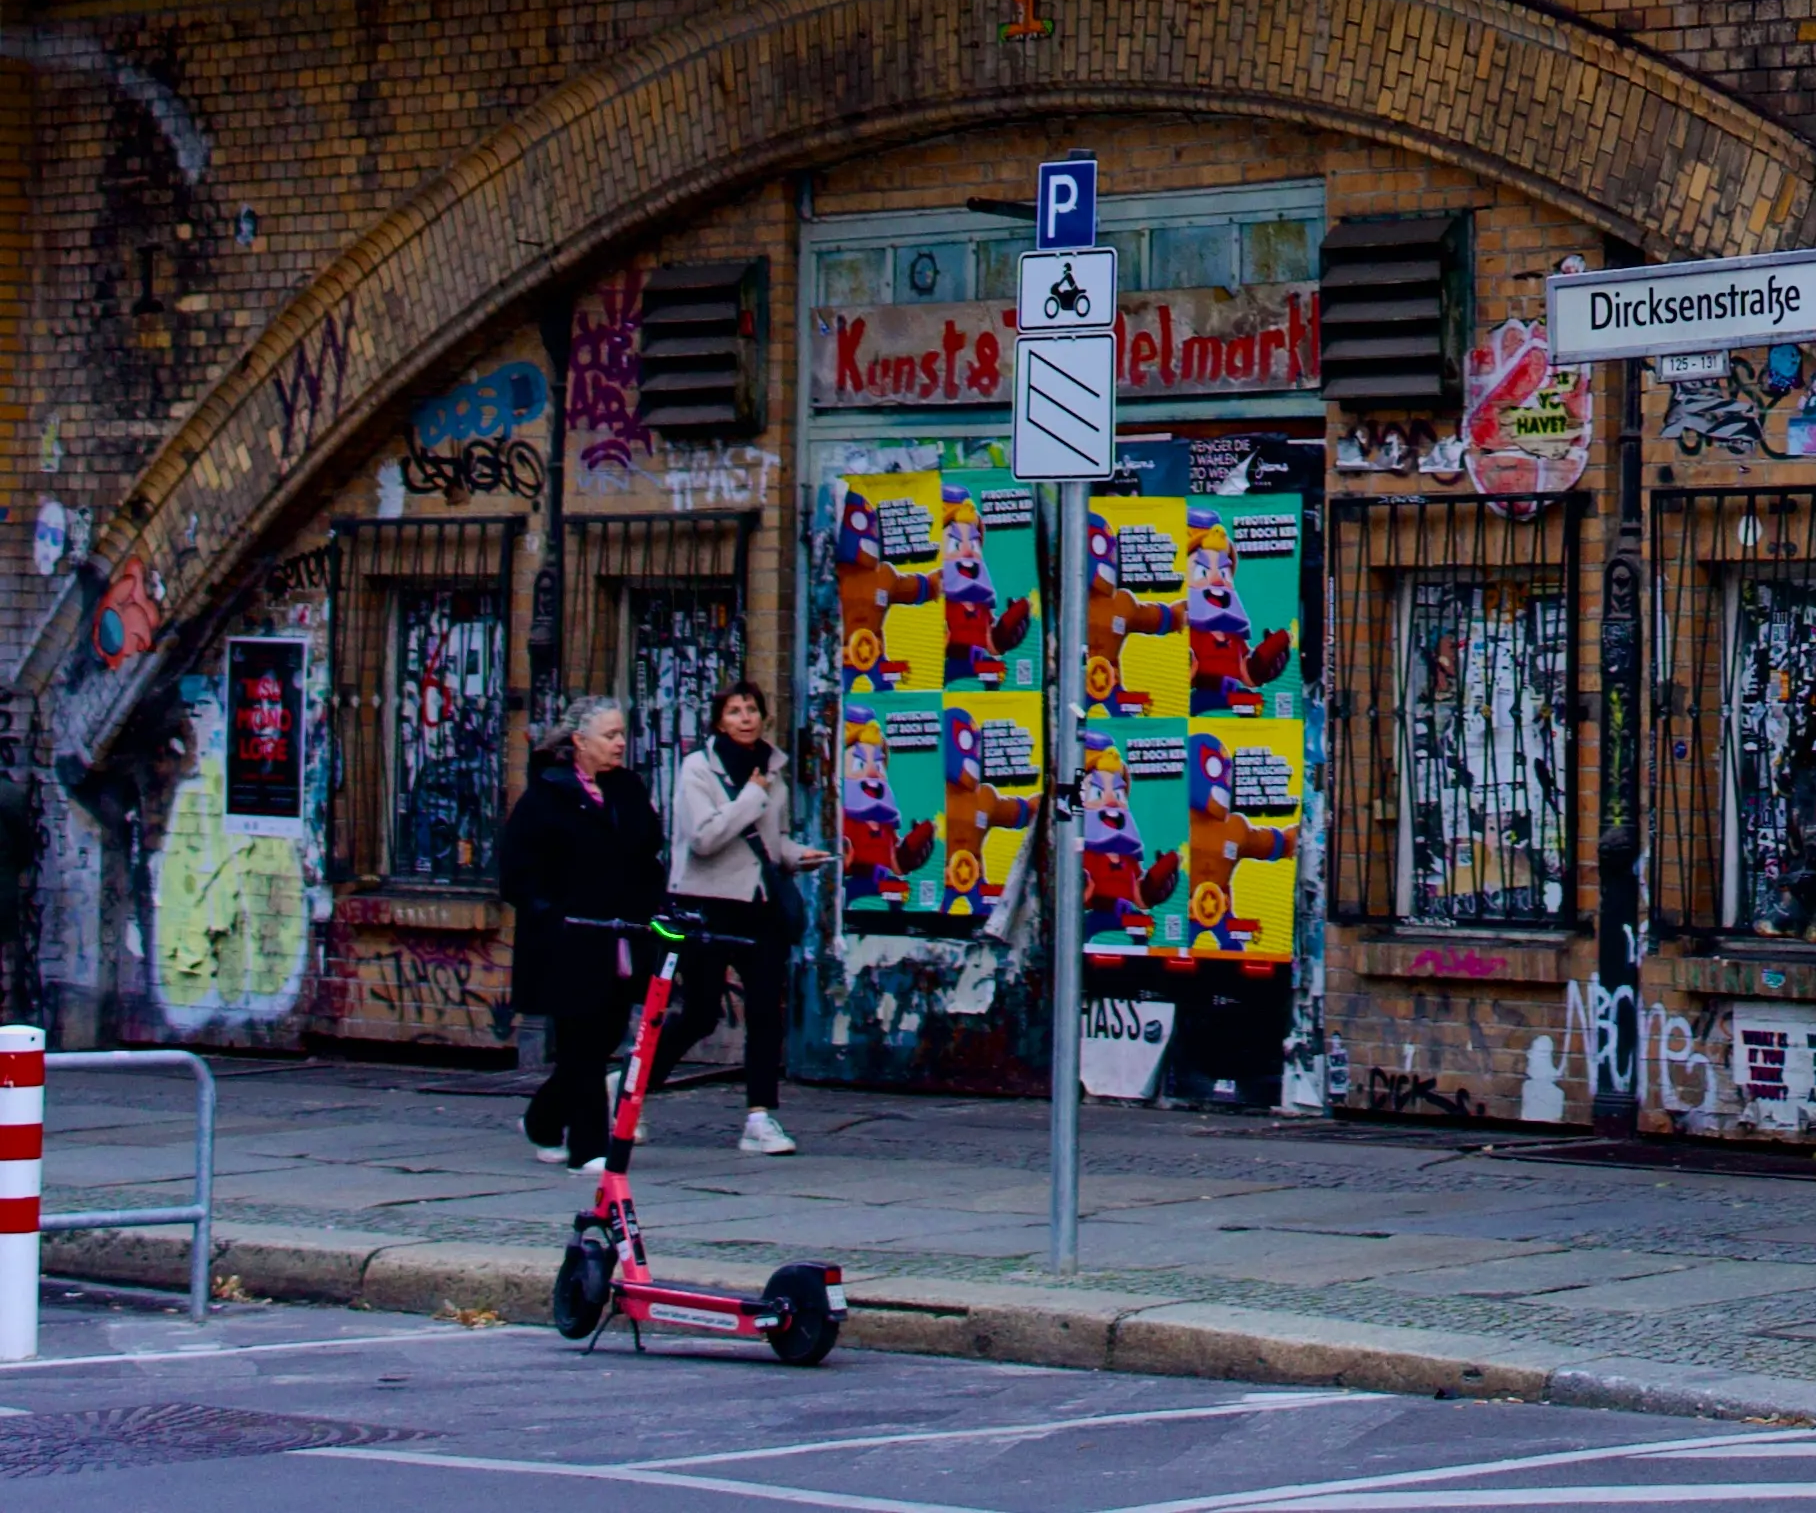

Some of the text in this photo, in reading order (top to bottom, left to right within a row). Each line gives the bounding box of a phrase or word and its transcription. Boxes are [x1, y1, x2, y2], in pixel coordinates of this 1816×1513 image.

[1047, 174, 1078, 239] P
[1591, 275, 1800, 330] Dircksenstraße
[1670, 357, 1689, 371] 125
[1701, 355, 1717, 369] 131
[1516, 415, 1567, 434] HAVE?
[1742, 1030, 1774, 1046] WHAT
